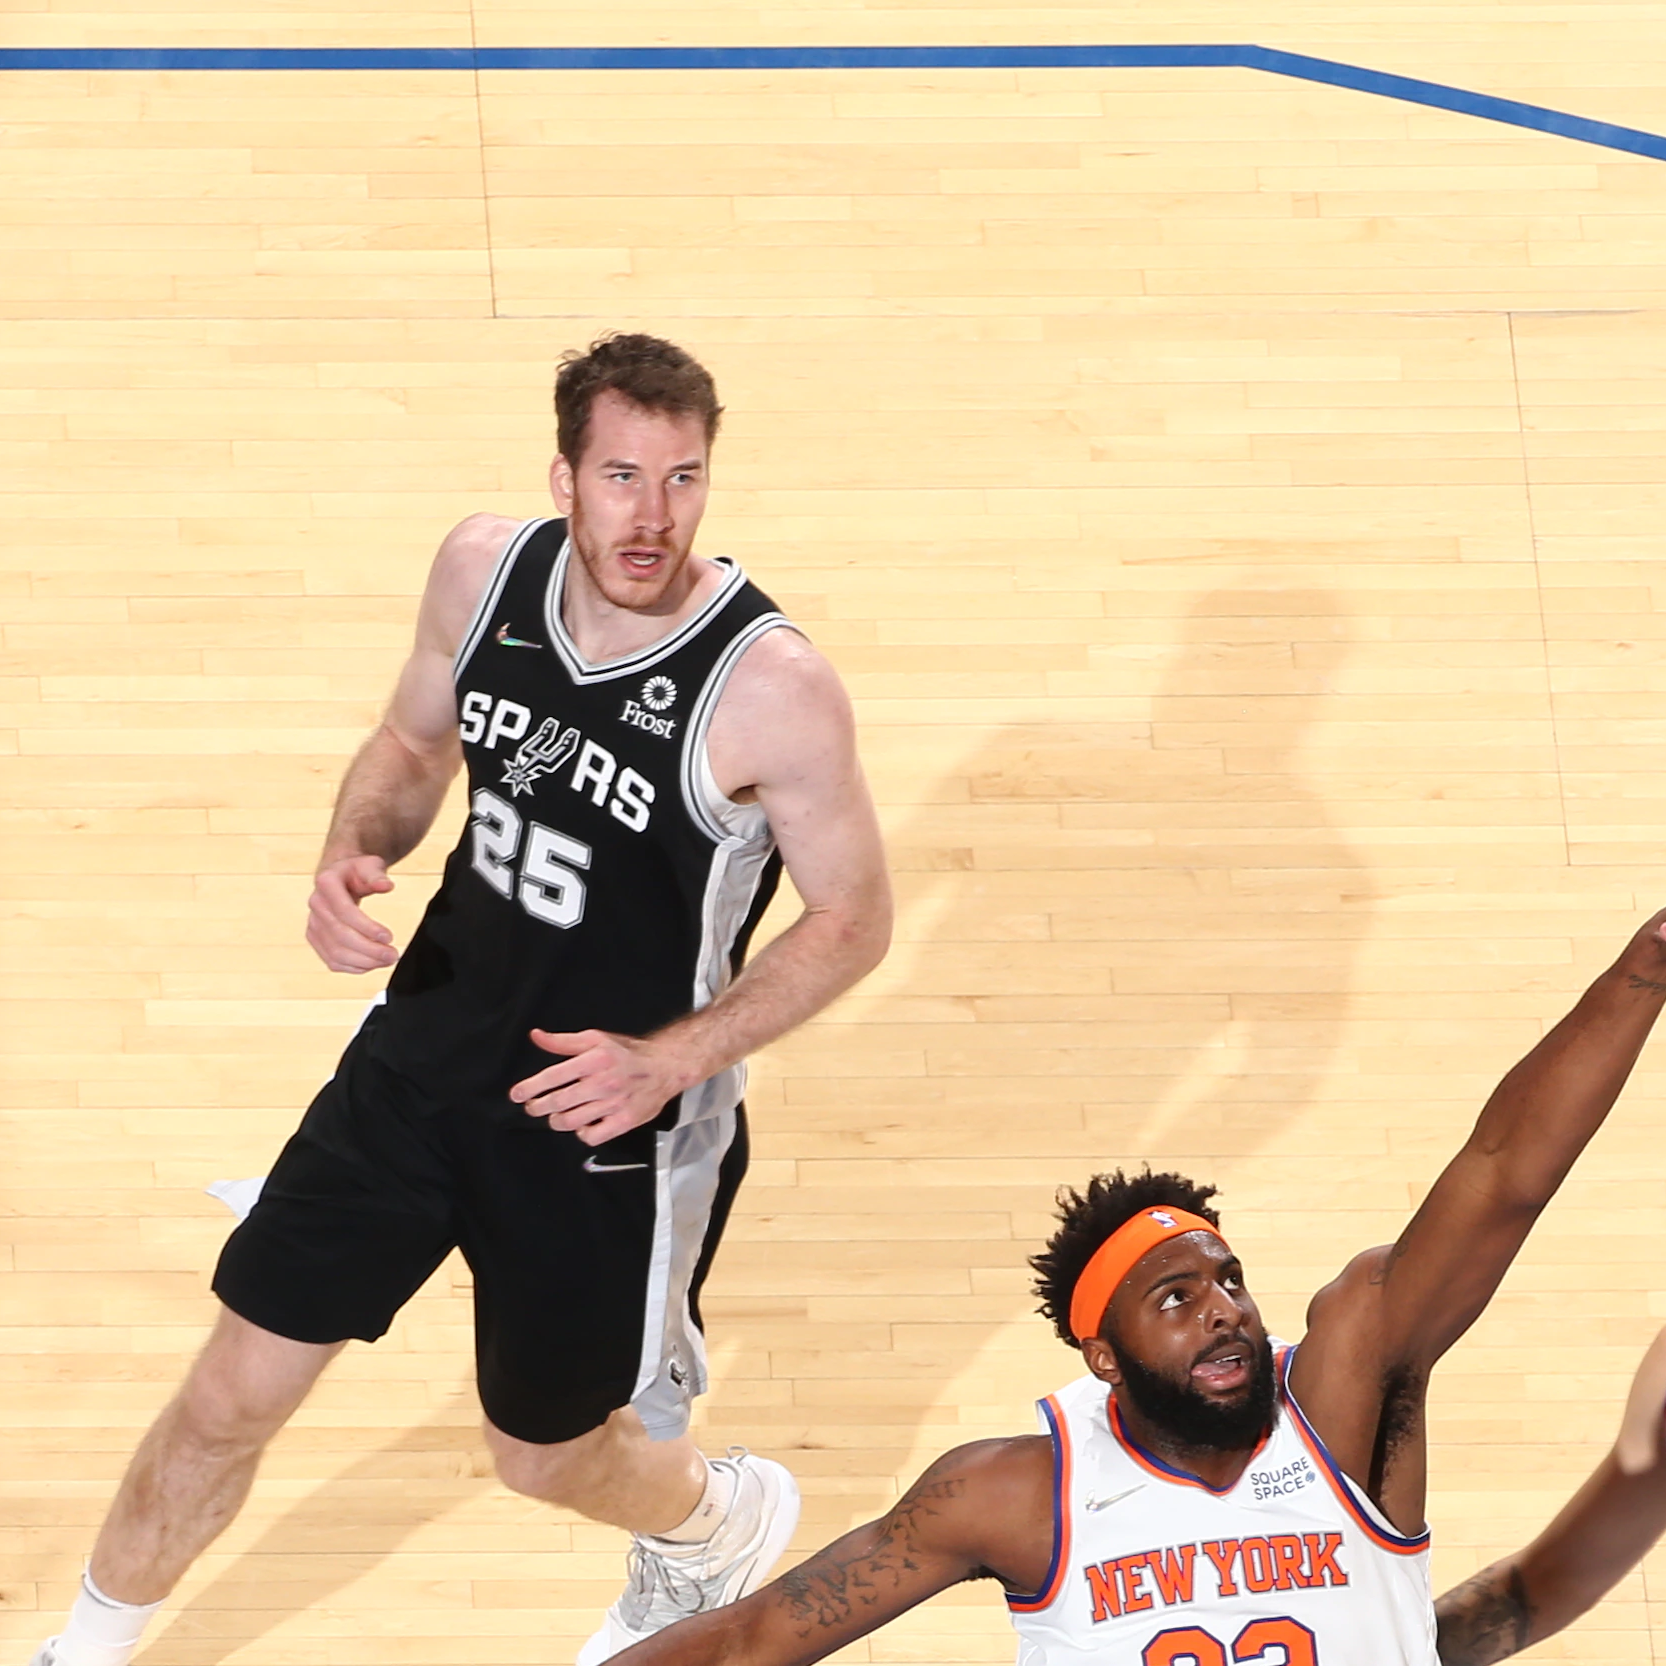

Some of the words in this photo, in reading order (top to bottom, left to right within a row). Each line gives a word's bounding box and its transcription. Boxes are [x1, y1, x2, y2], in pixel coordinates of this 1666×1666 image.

[619, 699, 677, 740] Frost
[471, 786, 592, 930] 25
[1250, 1456, 1310, 1486] SQUARE
[1254, 1476, 1305, 1501] SPACE
[1083, 1541, 1197, 1625] NEW
[1200, 1531, 1350, 1598] YORK
